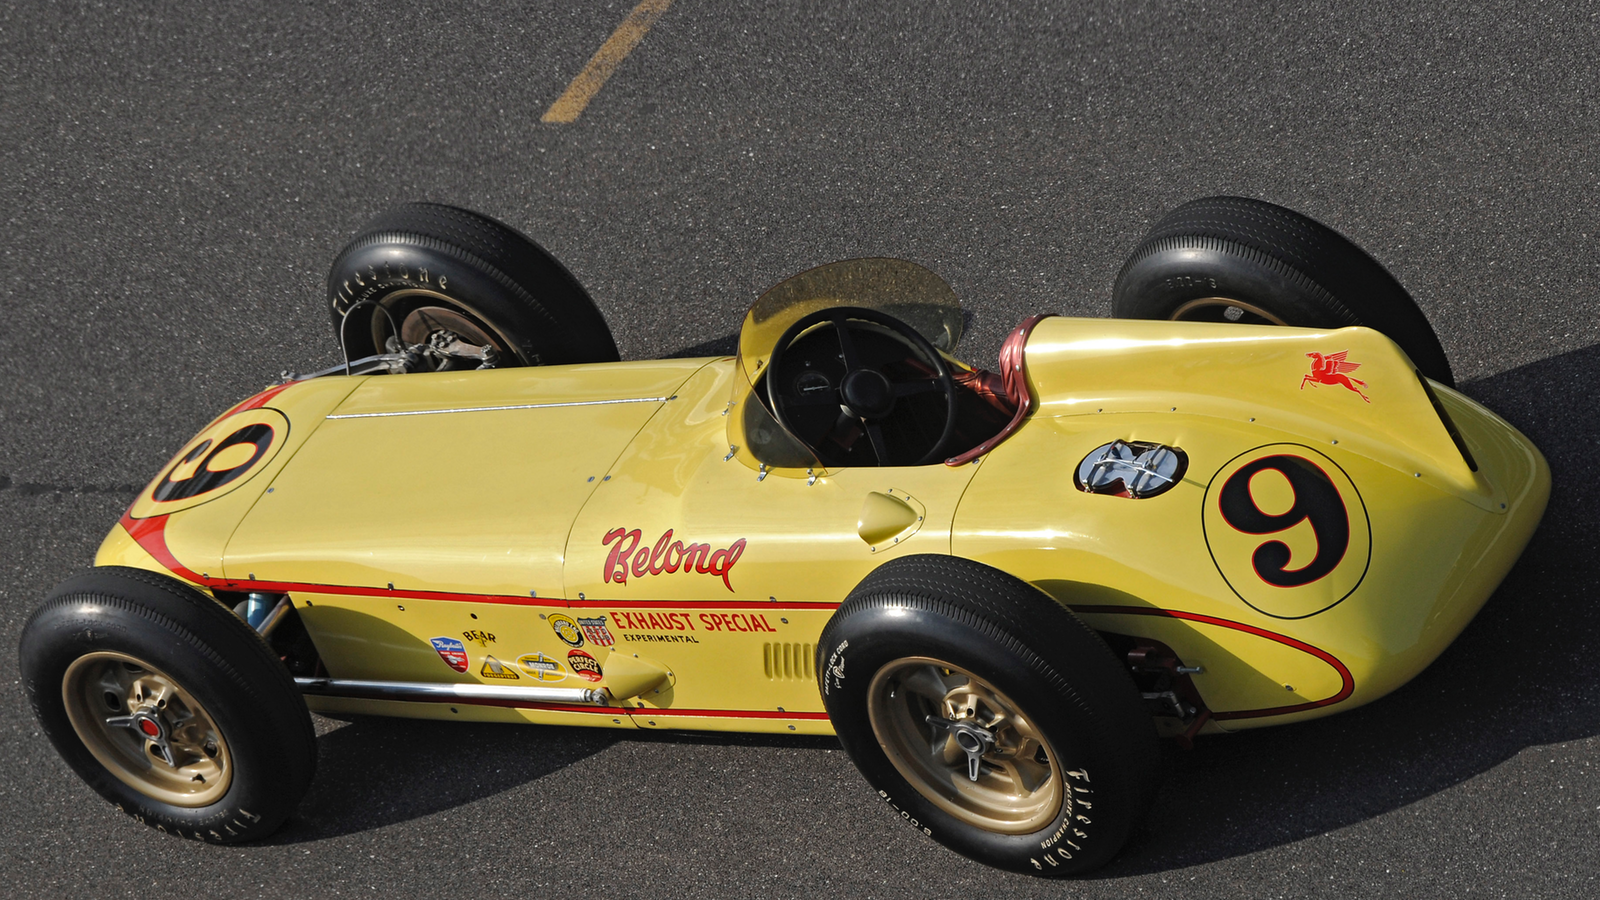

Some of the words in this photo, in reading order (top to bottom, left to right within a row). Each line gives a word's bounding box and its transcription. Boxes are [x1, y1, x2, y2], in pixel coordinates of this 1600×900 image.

[151, 423, 275, 503] 9
[1218, 454, 1350, 588] 9
[602, 527, 747, 593] Belond
[462, 629, 497, 643] BEAR
[609, 612, 695, 631] EXHAUST
[699, 613, 777, 633] SPECIAL
[588, 634, 611, 642] CLUB
[624, 634, 699, 644] EXPERIMENTAL
[568, 656, 598, 668] PERFECT
[573, 661, 599, 673] CIRCLE
[1064, 781, 1073, 818] DELUXE
[1030, 767, 1094, 871] Firestone
[1040, 817, 1070, 850] CHAMPION
